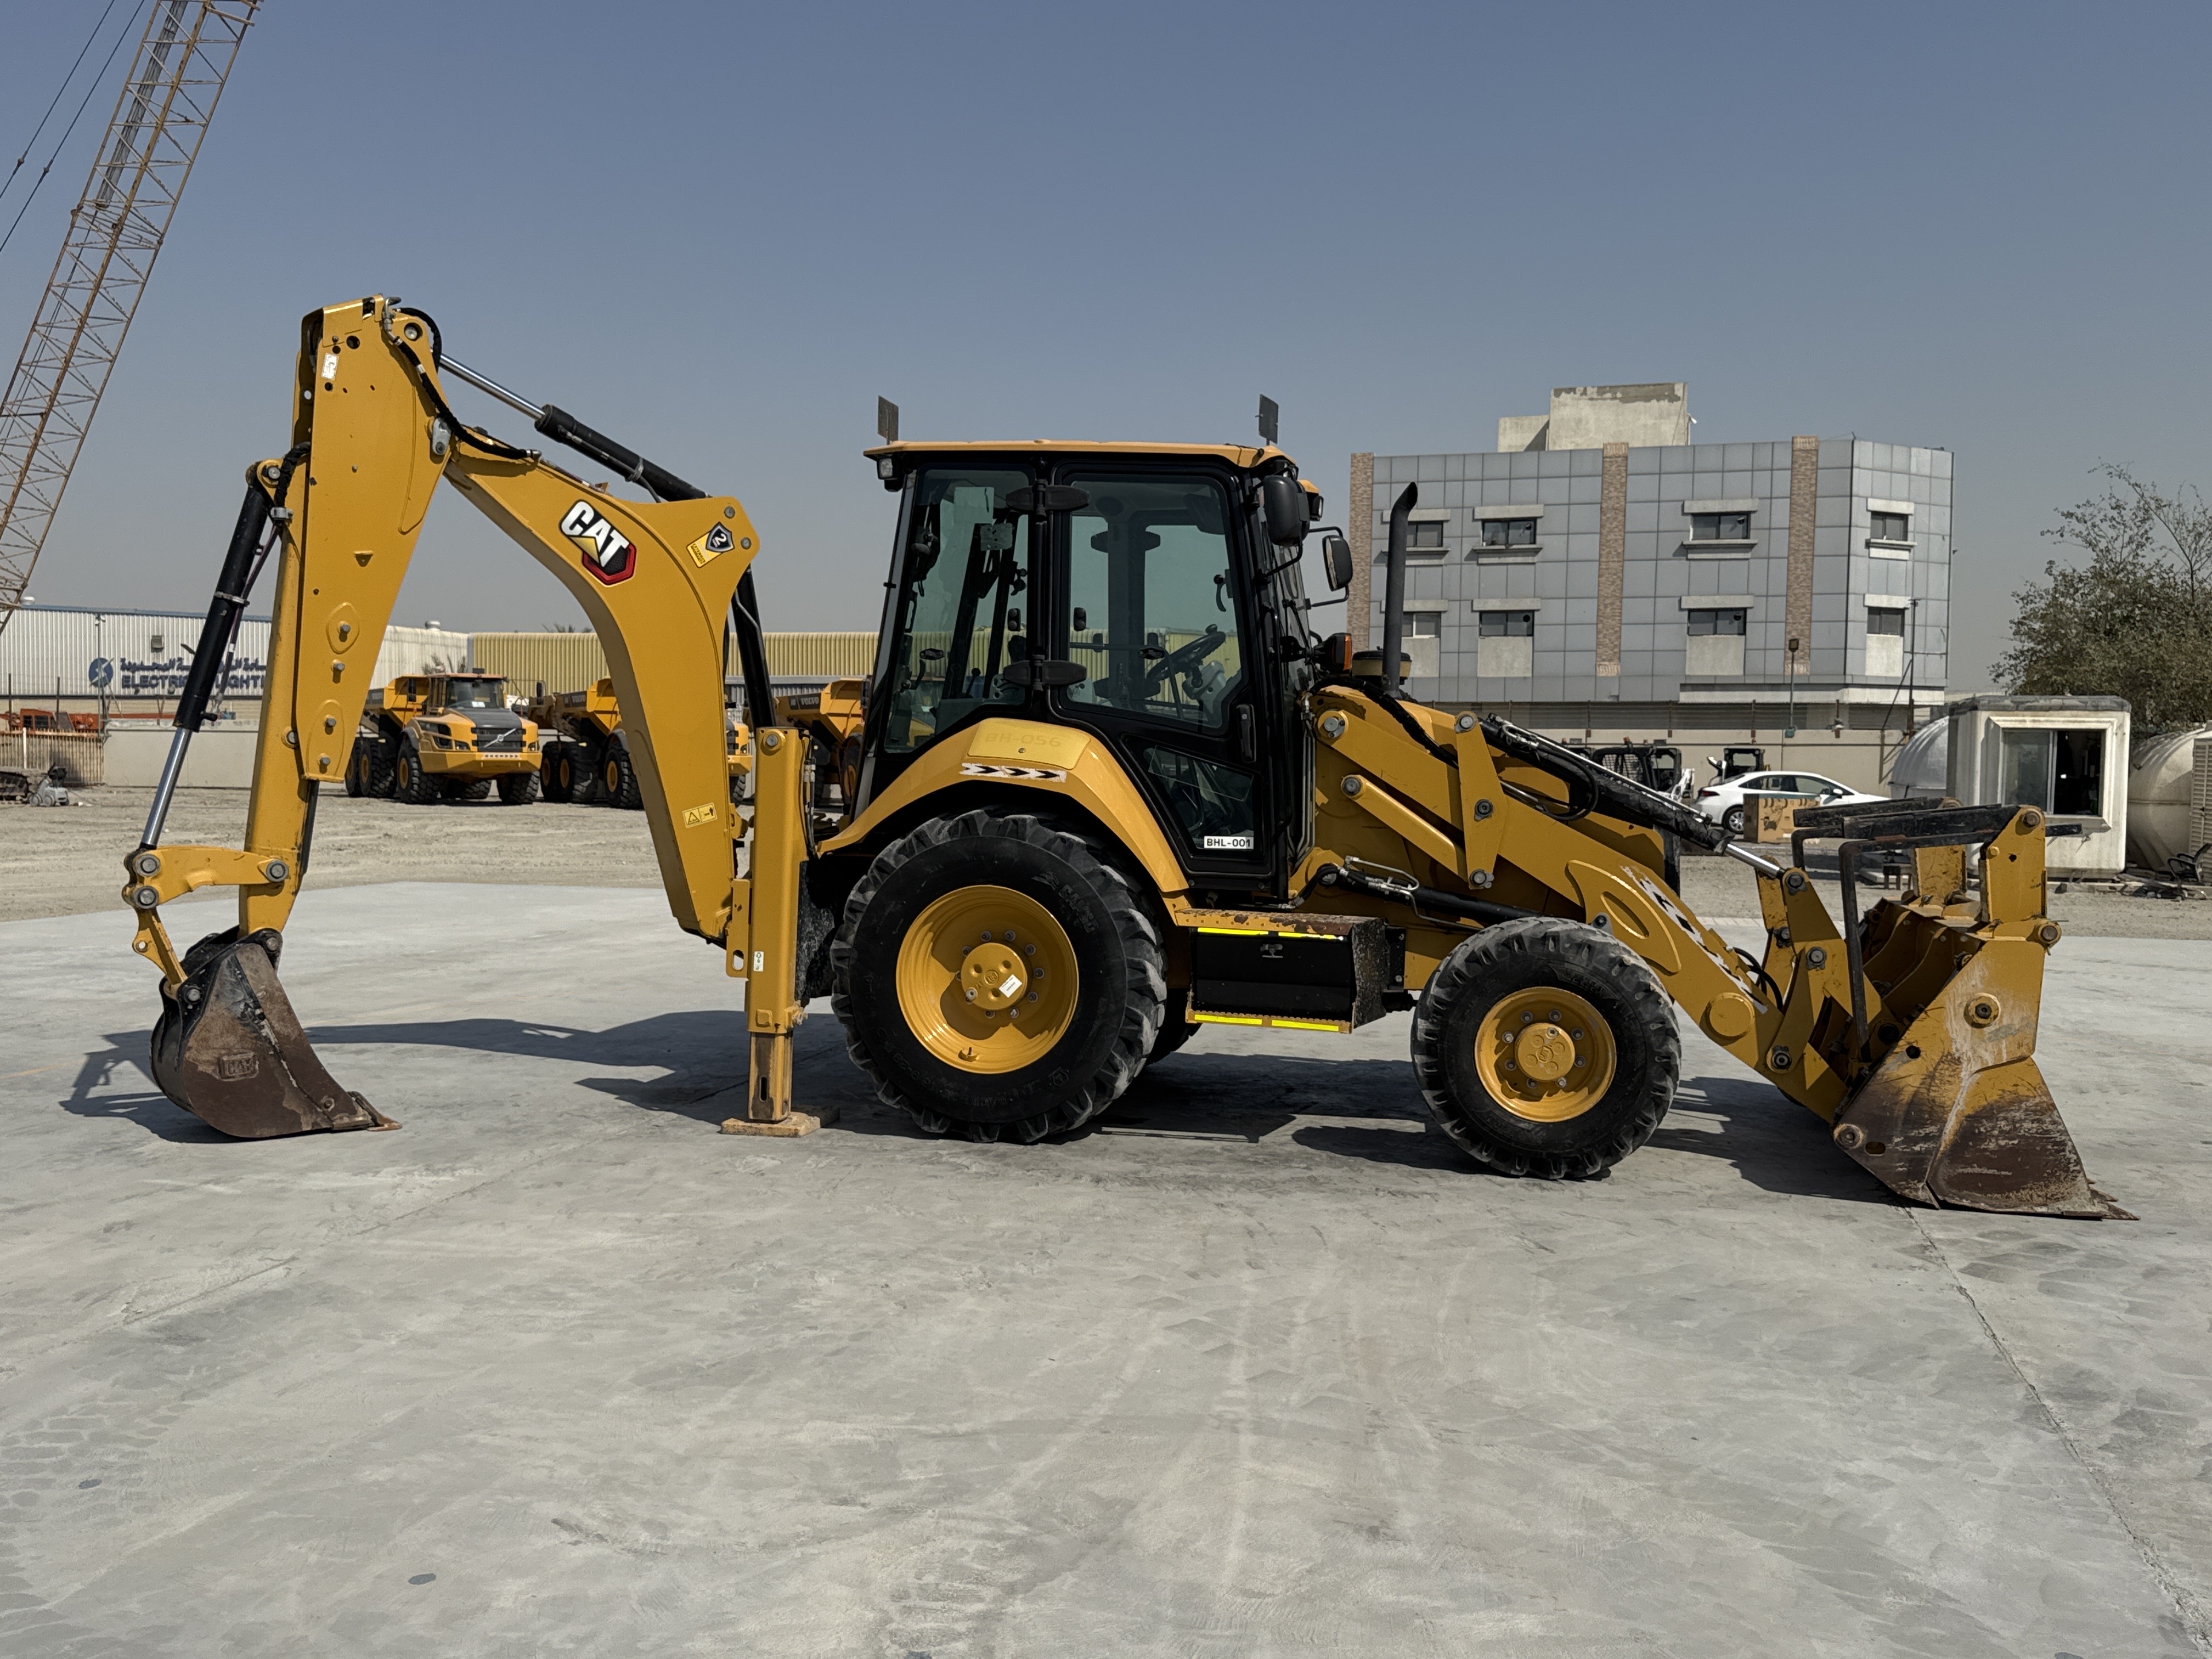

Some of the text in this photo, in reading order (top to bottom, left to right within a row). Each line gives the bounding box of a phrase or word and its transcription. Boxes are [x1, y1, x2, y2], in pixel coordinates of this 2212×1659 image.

[561, 501, 630, 568] CAT
[800, 696, 819, 706] VOLVO
[1206, 838, 1250, 848] BHL-001
[1058, 884, 1099, 934] CAMSO
